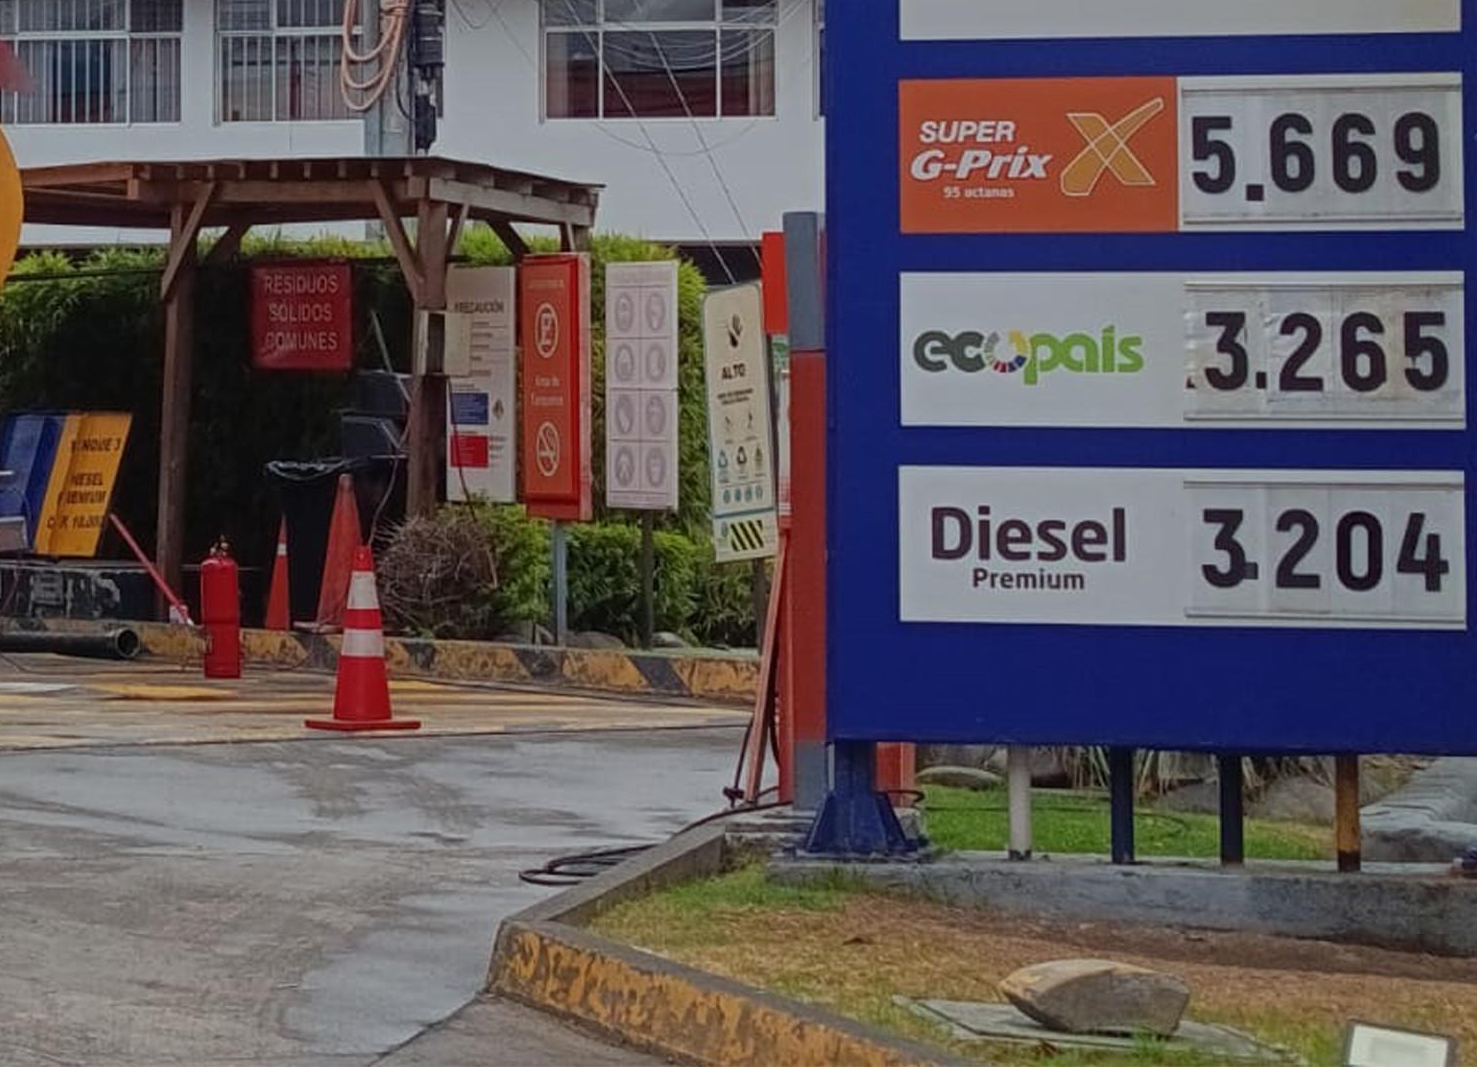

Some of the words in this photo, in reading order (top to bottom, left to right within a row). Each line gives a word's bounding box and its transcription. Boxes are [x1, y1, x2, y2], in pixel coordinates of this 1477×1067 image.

[919, 120, 1015, 144] SUPER
[910, 146, 1053, 181] G-Prix
[1191, 112, 1441, 202] 5.669
[943, 186, 961, 199] 95
[264, 275, 339, 294] RESIDUOS
[265, 332, 338, 351] COMUNES
[1204, 311, 1449, 392] 3.265
[721, 363, 746, 380] ALTO
[931, 506, 1126, 562] Diesel
[1202, 509, 1450, 592] 3.204
[972, 568, 1085, 589] Premium
